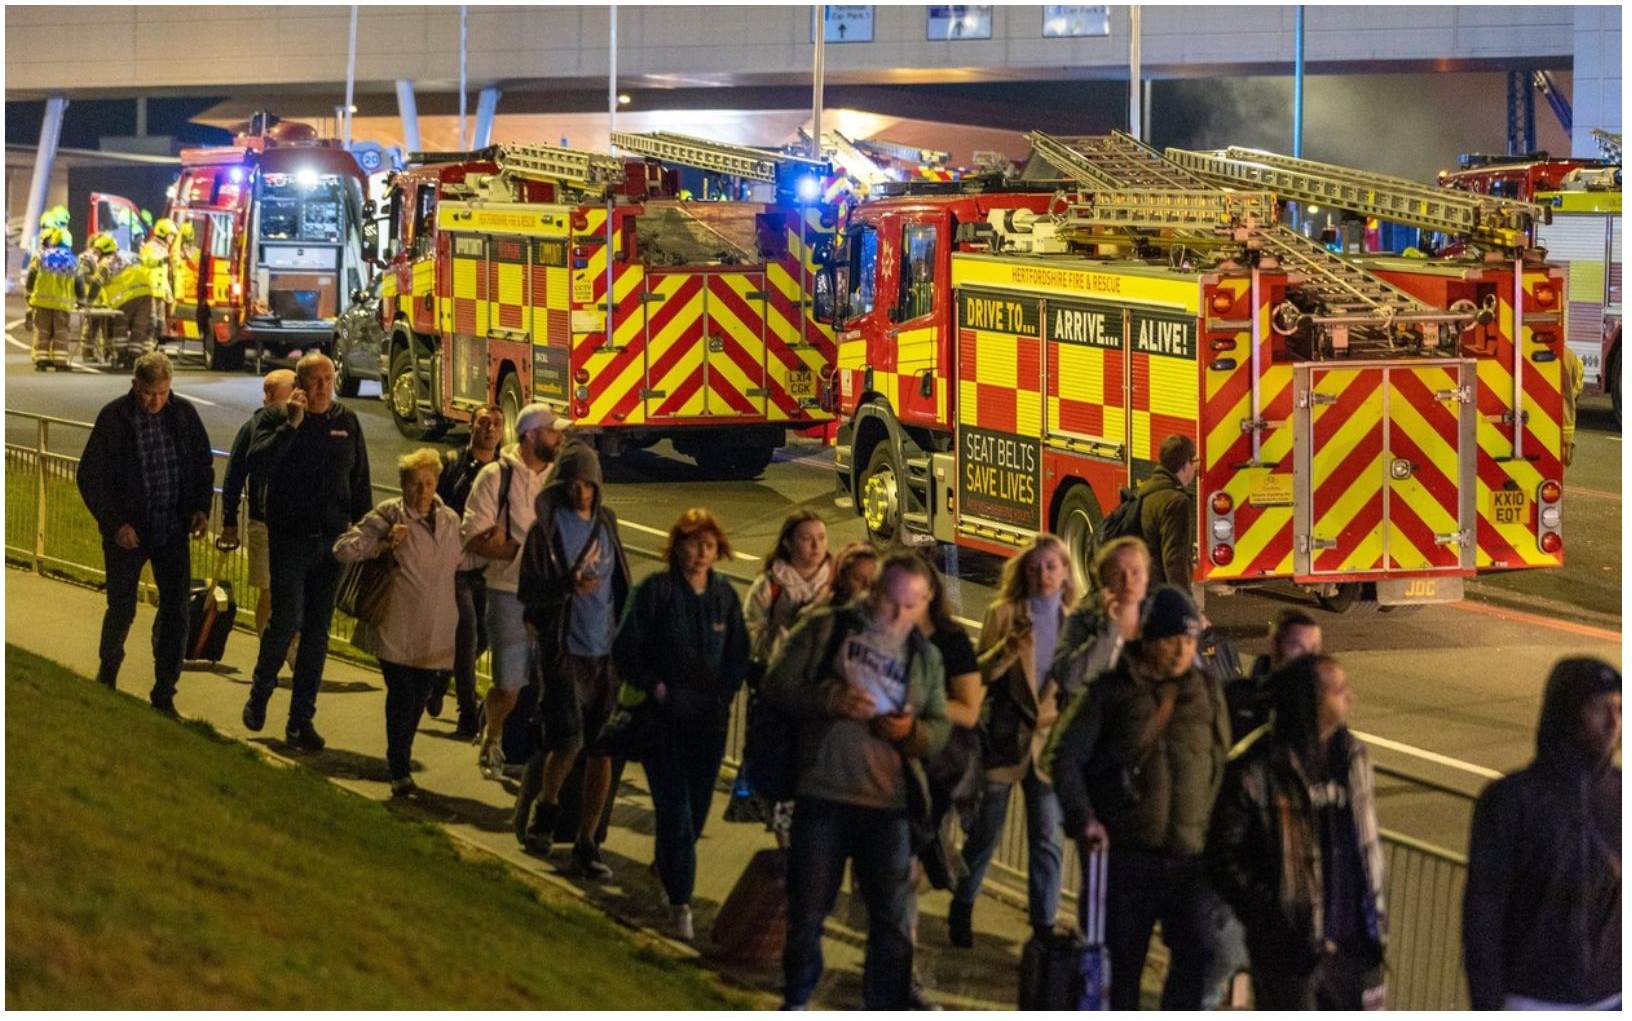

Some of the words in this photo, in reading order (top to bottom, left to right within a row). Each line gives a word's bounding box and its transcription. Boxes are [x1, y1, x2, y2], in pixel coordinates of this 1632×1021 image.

[365, 155, 379, 164] 20
[1012, 267, 1067, 288] HERTFORDSHIRE
[1068, 272, 1084, 290] FIRE
[1086, 274, 1091, 290] &
[1092, 275, 1121, 294] RESCUE
[966, 297, 1003, 330] DRIVE
[1007, 303, 1036, 334] TO...
[1054, 309, 1119, 346] ARRIVE...
[1138, 319, 1188, 355] ALIVE!
[966, 433, 995, 464] SEAT
[997, 438, 1035, 473] BELTS
[966, 463, 997, 497] SAVE
[1000, 469, 1035, 505] LIVES
[1494, 492, 1525, 506] KX10
